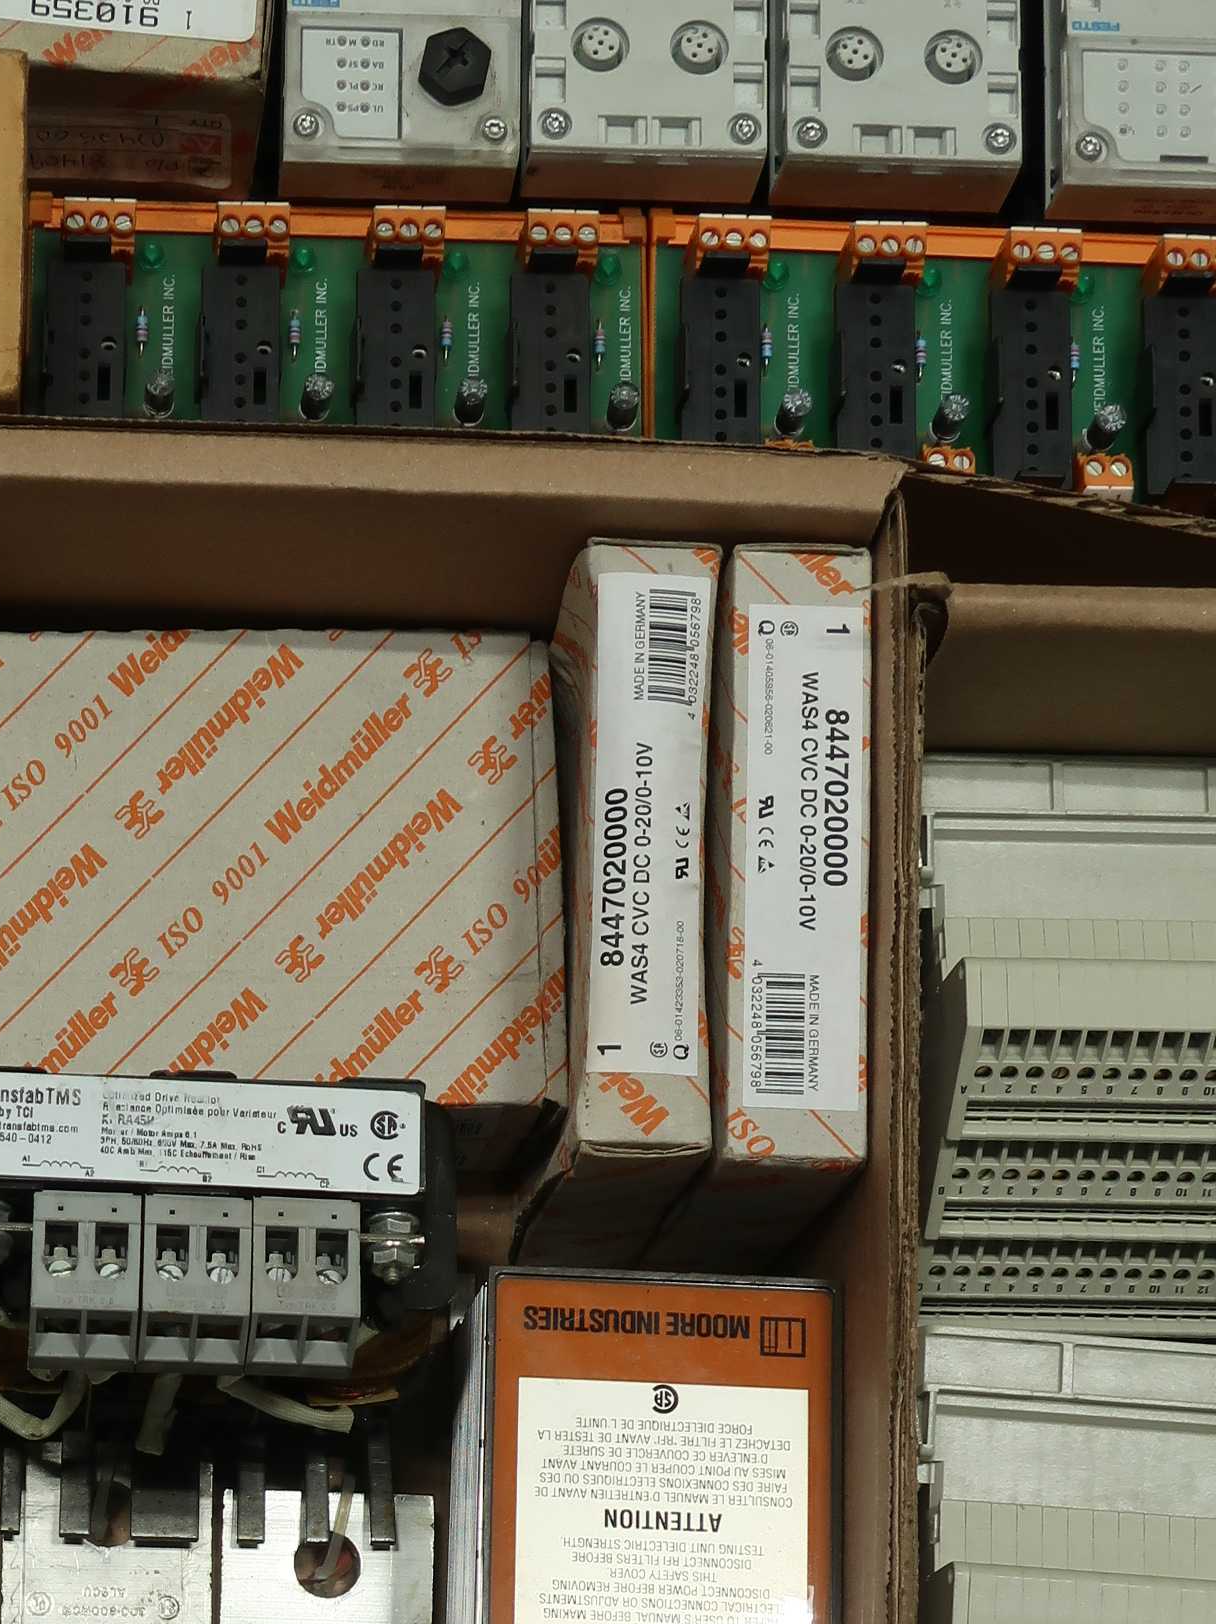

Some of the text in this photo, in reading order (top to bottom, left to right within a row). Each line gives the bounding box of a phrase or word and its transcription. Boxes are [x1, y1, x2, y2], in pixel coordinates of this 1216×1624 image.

[30, 0, 159, 27] 910359
[1072, 21, 1120, 32] FESTO
[163, 274, 175, 300] INC.
[316, 278, 328, 303] INC.
[468, 282, 480, 307] INC.
[620, 286, 631, 311] INC.
[788, 293, 799, 318] INC.
[940, 299, 952, 325] INC.
[1092, 306, 1104, 331] INC.
[634, 591, 646, 700] MADE IN GERMANY
[688, 598, 701, 703] 032248 056798
[156, 643, 306, 797] Weidmüller
[0, 695, 114, 811] ISO 9001
[824, 624, 850, 887] 1 8447020000
[798, 672, 819, 930] WAS4 CVC DC 0-20/0-10V
[156, 692, 412, 959] ISO 9001 Weidmüller
[316, 788, 464, 941] Weidmüller
[630, 742, 654, 1005] WAS4 CVC DC 0-20/0-10V
[460, 902, 509, 956] ISO
[597, 787, 628, 1056] 1 8447020000
[751, 977, 762, 1087] 032248 056798
[808, 975, 819, 1092] MADE IN GERMANY
[339, 1124, 358, 1137] US
[524, 1306, 750, 1340] MOORE INDUSTRIES
[619, 1418, 634, 1430] DE
[538, 1472, 754, 1493] DES OU DES
[534, 1486, 793, 1508] CONSULTER LE MANUEL AVANT DE
[604, 1509, 722, 1534] ATTENTION
[624, 1538, 686, 1553] DIELECTRIC
[571, 1551, 752, 1570] DISCONNECT RFI FILTERS BEFORE
[552, 1579, 770, 1599] DISCONNECT POWER BEFORE REMOVING
[649, 1569, 717, 1583] THIS SAFETY
